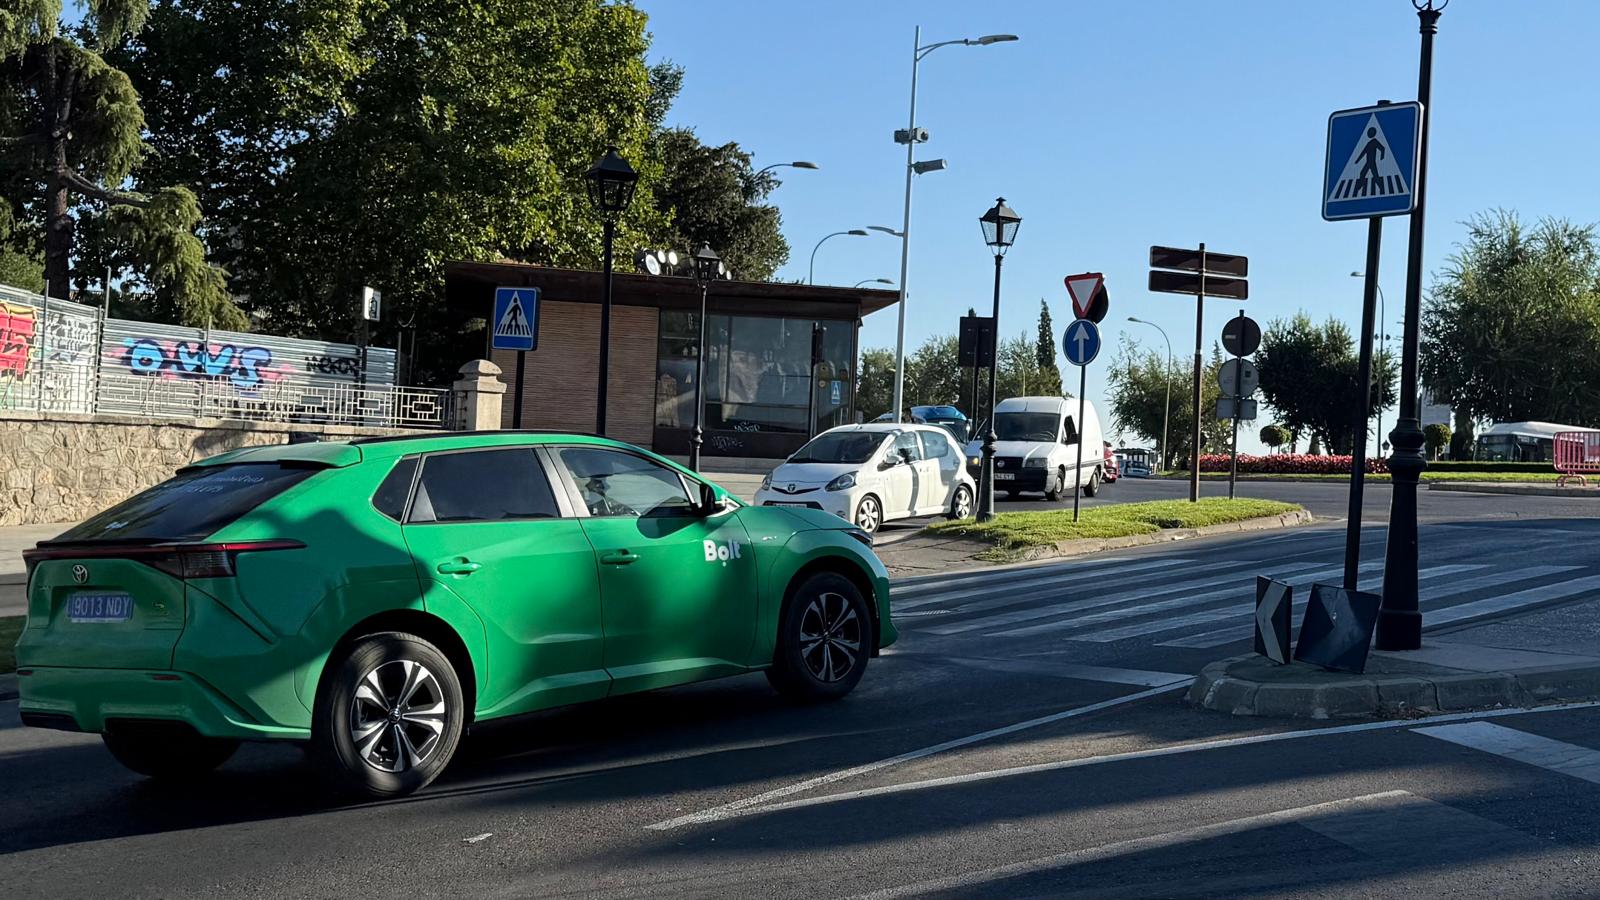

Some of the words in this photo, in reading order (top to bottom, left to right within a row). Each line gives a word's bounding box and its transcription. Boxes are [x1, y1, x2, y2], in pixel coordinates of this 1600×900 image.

[703, 538, 741, 566] Bolt
[74, 597, 103, 616] 9013
[105, 597, 130, 616] NDY
